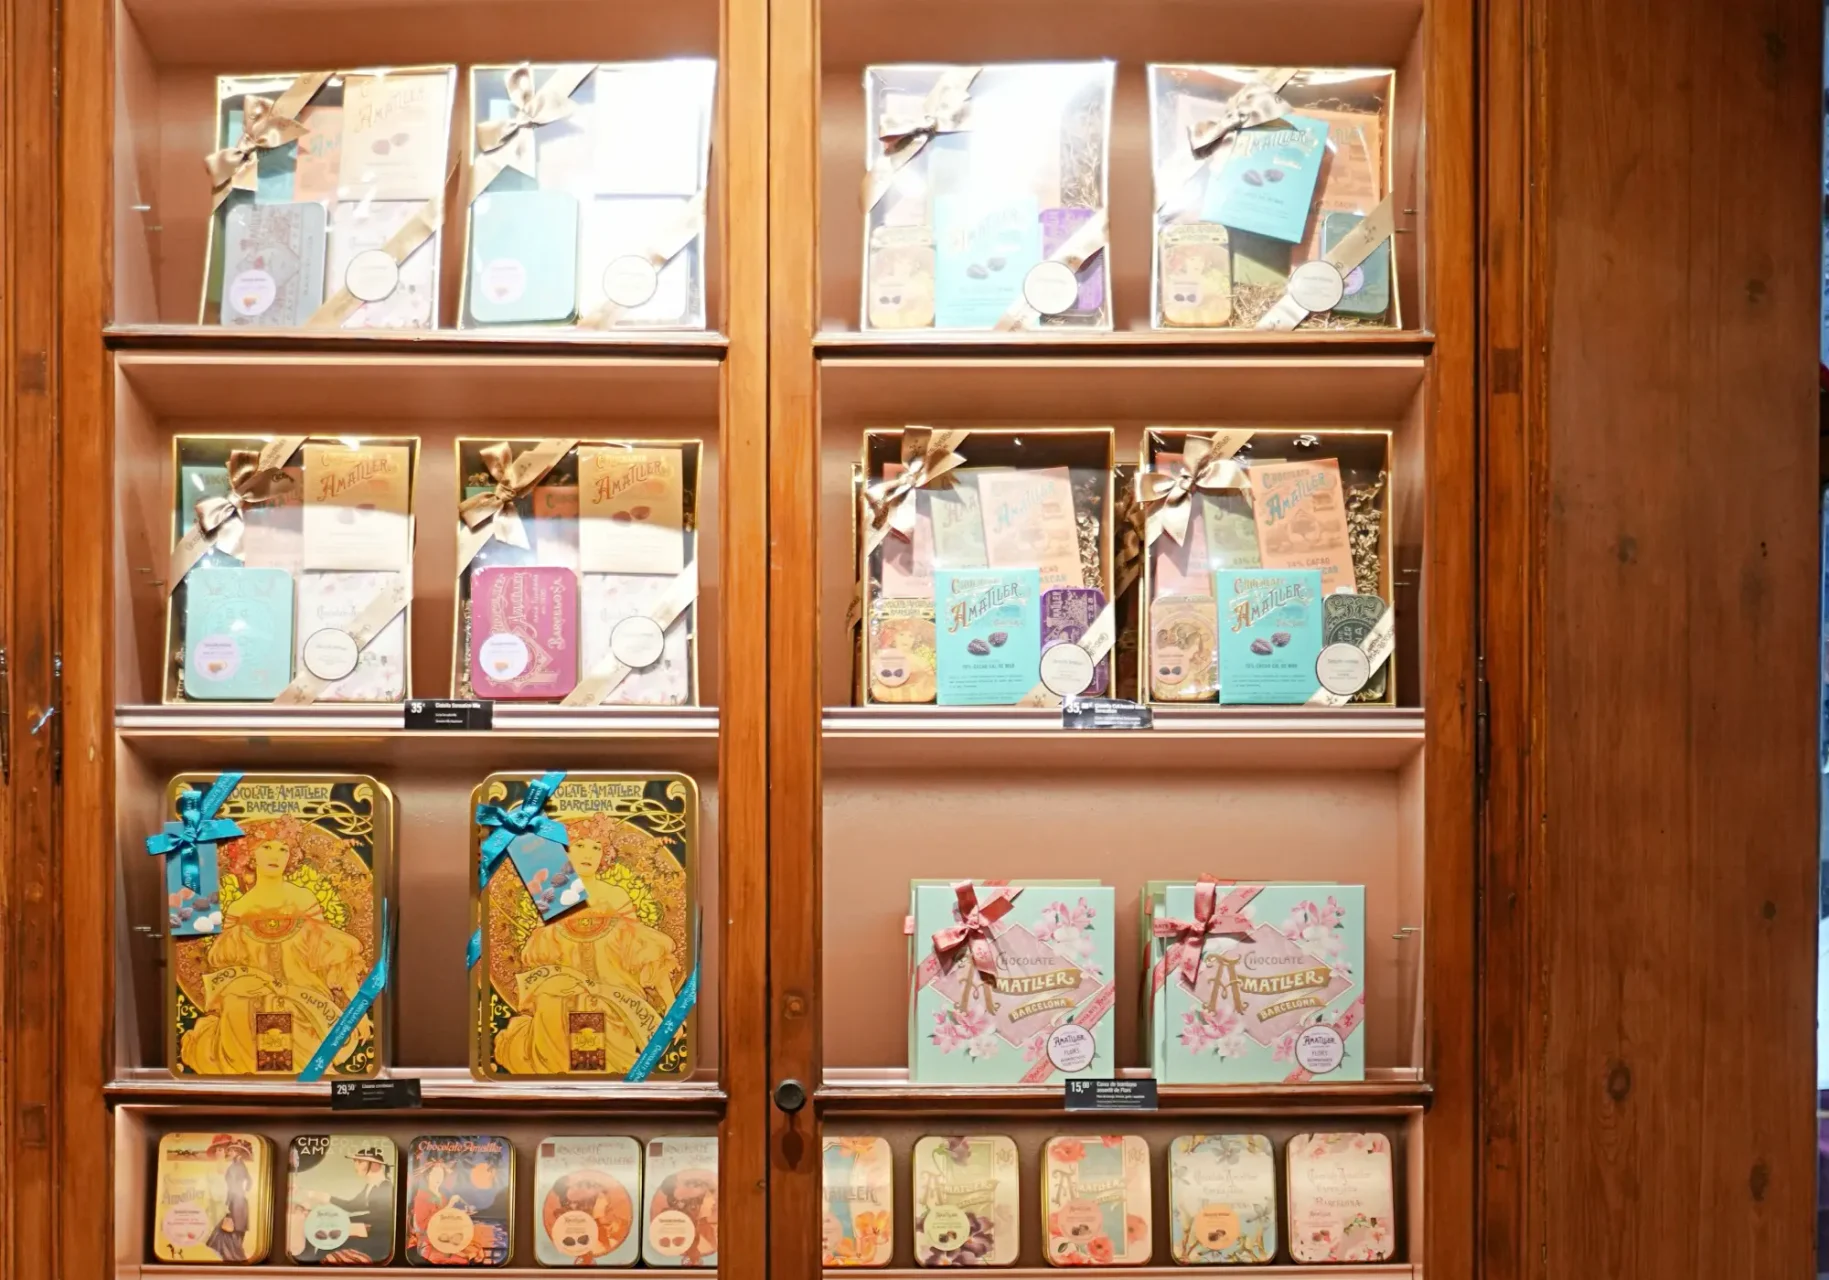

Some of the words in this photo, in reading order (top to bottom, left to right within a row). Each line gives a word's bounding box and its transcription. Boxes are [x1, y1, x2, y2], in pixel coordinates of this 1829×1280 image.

[593, 460, 662, 504] AMATLLER
[948, 583, 1021, 633] AMATLLER
[1231, 583, 1303, 632] AMATLLER
[231, 785, 274, 800] OCOLATE
[276, 784, 328, 799] AMATLLER
[555, 784, 588, 798] OLATE
[589, 783, 642, 798] AMATLLER
[246, 801, 300, 814] BARCELONA
[559, 799, 614, 813] BARCELONA
[995, 952, 1056, 971] CHOCOLATE
[1243, 952, 1305, 970] CHOCOLATE
[1011, 998, 1068, 1020] BARCELONA
[1259, 997, 1317, 1020] BARCELONA
